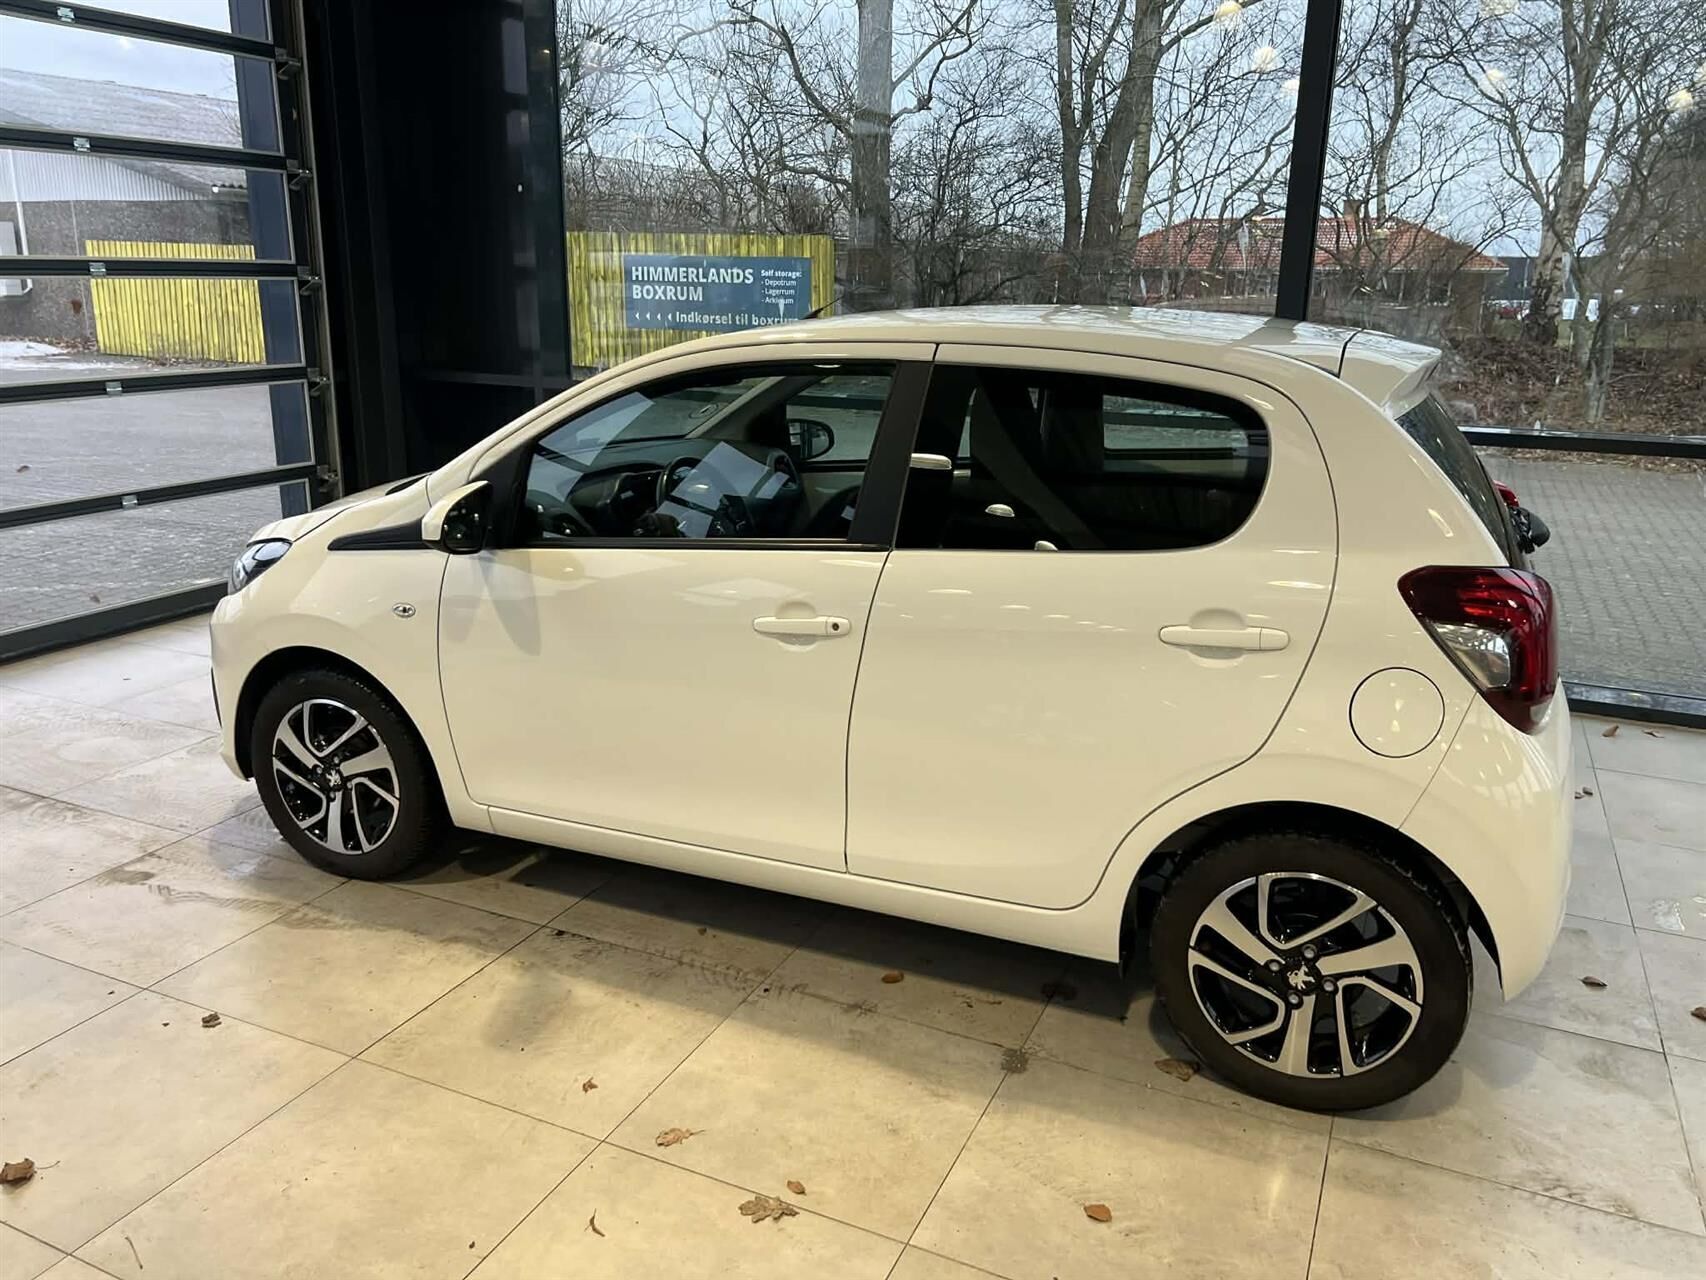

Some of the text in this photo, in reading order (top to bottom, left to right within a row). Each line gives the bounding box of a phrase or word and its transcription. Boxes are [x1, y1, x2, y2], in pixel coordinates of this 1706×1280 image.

[631, 266, 754, 284] HIMMERLANDS
[761, 269, 774, 277] Self
[765, 279, 797, 287] Depotrum
[632, 285, 703, 302] BOXRUM
[765, 288, 795, 296] Lagerrum
[676, 311, 799, 326] Indkørsel til boxru
